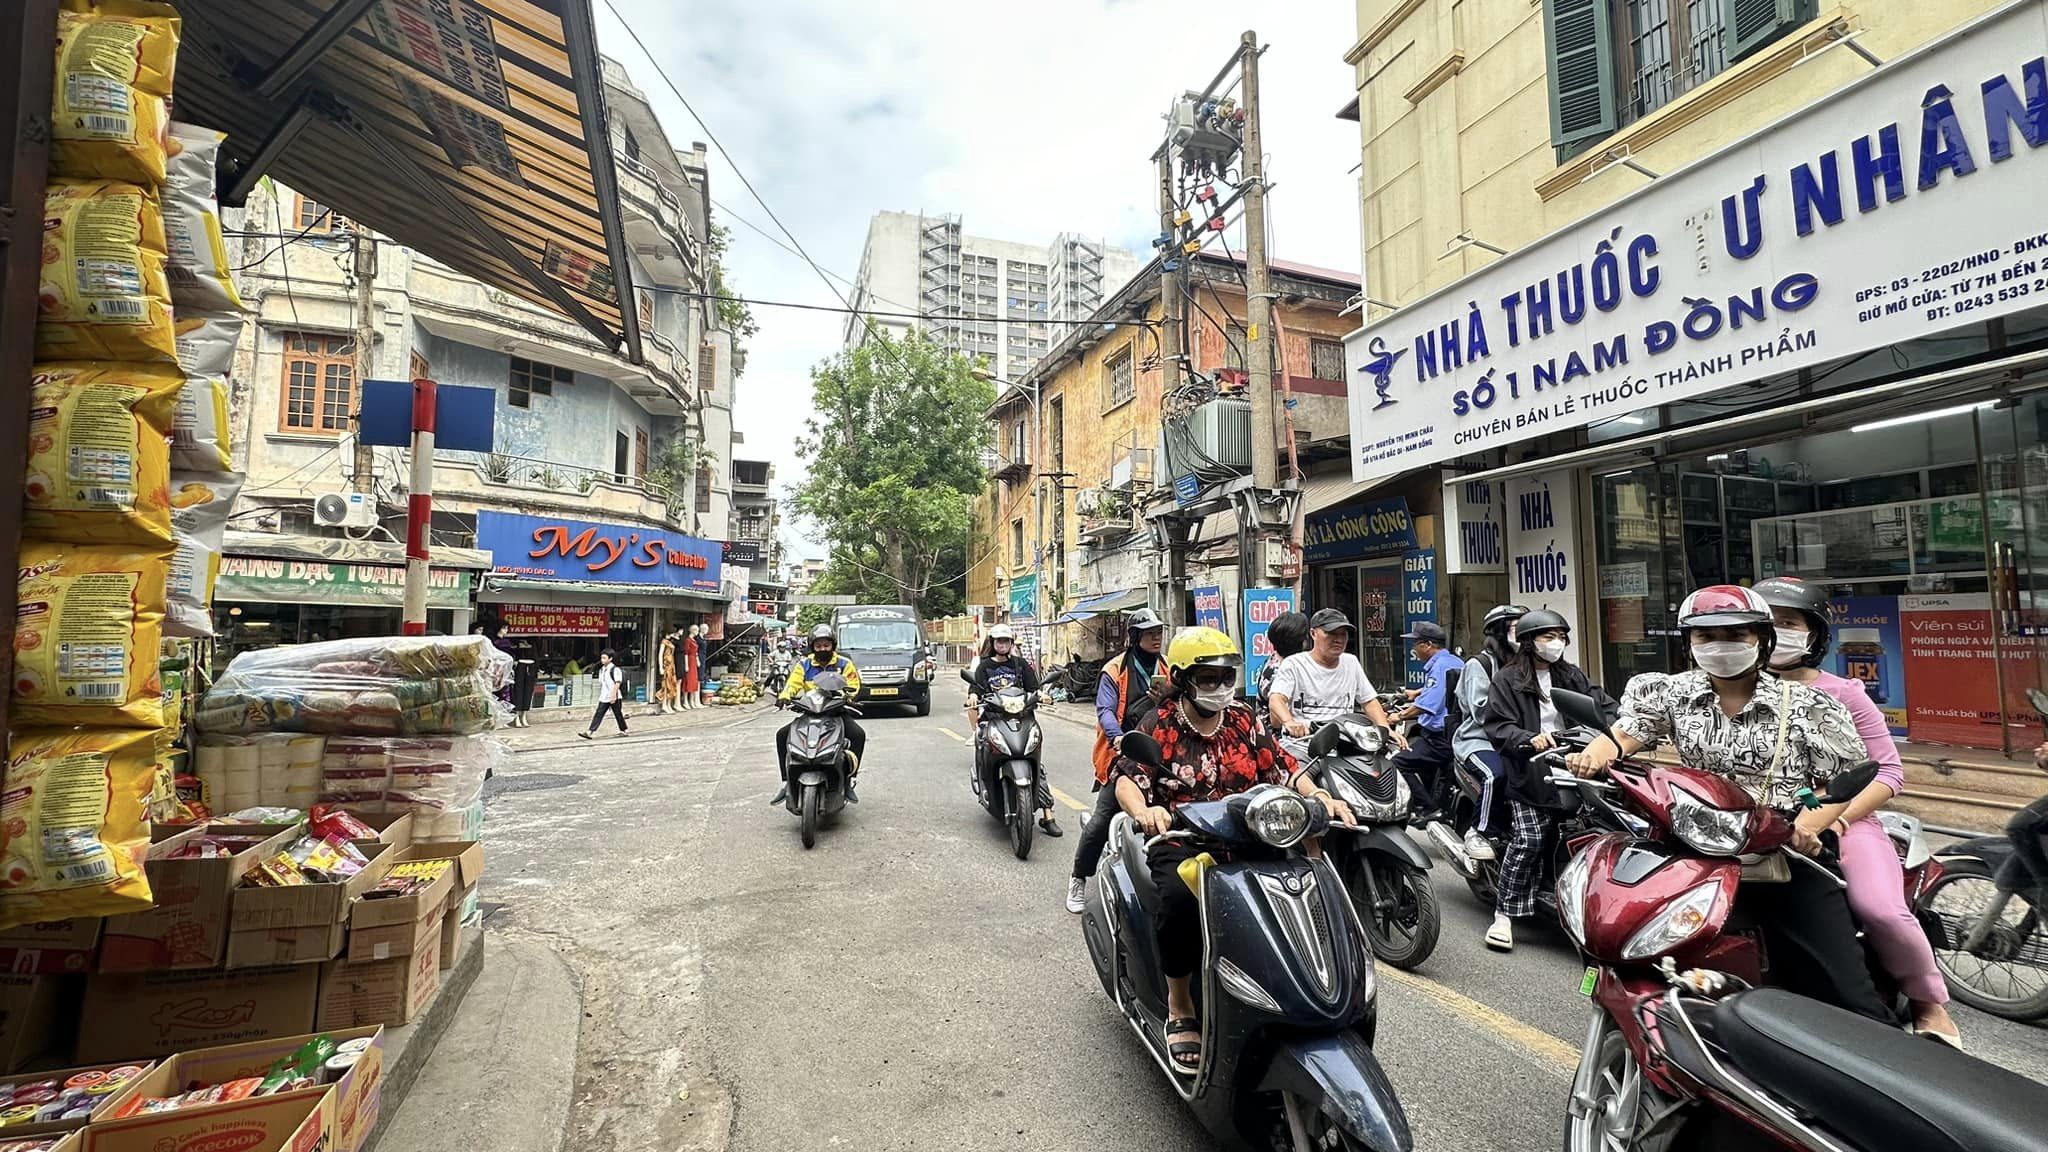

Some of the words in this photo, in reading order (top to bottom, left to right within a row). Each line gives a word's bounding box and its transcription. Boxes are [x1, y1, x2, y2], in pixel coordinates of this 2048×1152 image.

[1415, 302, 1490, 383] NHÀ
[1501, 226, 1661, 347] THUỐC
[1789, 55, 2048, 237] NHÂN
[1855, 284, 1888, 303] GPS:
[1891, 277, 1910, 292] 03
[1921, 249, 2000, 283] 2202/HNO
[1858, 303, 1881, 323] GIỜ
[1885, 296, 1908, 316] MỞ
[1911, 287, 1948, 308] CỬA:
[1951, 278, 1972, 297] TỪ
[1975, 272, 1997, 290] 7H
[2001, 260, 2037, 282] ĐẾN
[1926, 305, 1951, 321] ĐT:
[1954, 292, 1994, 314] 0243
[1998, 282, 2029, 301] 533
[1452, 366, 1497, 416] SỐ
[1505, 372, 1521, 399] 1
[1533, 333, 1629, 392] NAM
[1643, 271, 1820, 356] ĐỒNG
[1454, 415, 1512, 445] CHUYÊN
[1516, 407, 1549, 428] BÁN
[1554, 395, 1575, 417] LẺ
[1580, 376, 1648, 412] THUỐC
[1655, 356, 1736, 389] THÀNH
[1739, 325, 1817, 366] PHẨM
[1520, 482, 1554, 531] NHÀ
[1335, 514, 1369, 540] CÔNG
[1371, 507, 1408, 539] CỘNG
[1461, 506, 1500, 565] THUỐC
[1404, 555, 1433, 573] GIẶT
[1515, 539, 1567, 593] THUỐC
[1411, 575, 1428, 592] KÝ
[540, 615, 567, 626] 30%
[579, 616, 604, 627] 50%
[1407, 596, 1433, 614] ƯỚT
[1911, 619, 1953, 631] Viên
[1957, 618, 1985, 631] sủi
[1911, 634, 1945, 646] PHÒNG
[1947, 635, 1980, 646] NGỪA
[1912, 648, 1935, 658] TÌNH
[1938, 648, 1973, 660] TRẠNG
[1846, 662, 1880, 681] JEX
[1916, 706, 1935, 716] Sản
[1936, 706, 1959, 718] xuất
[1960, 707, 1977, 718] bởi
